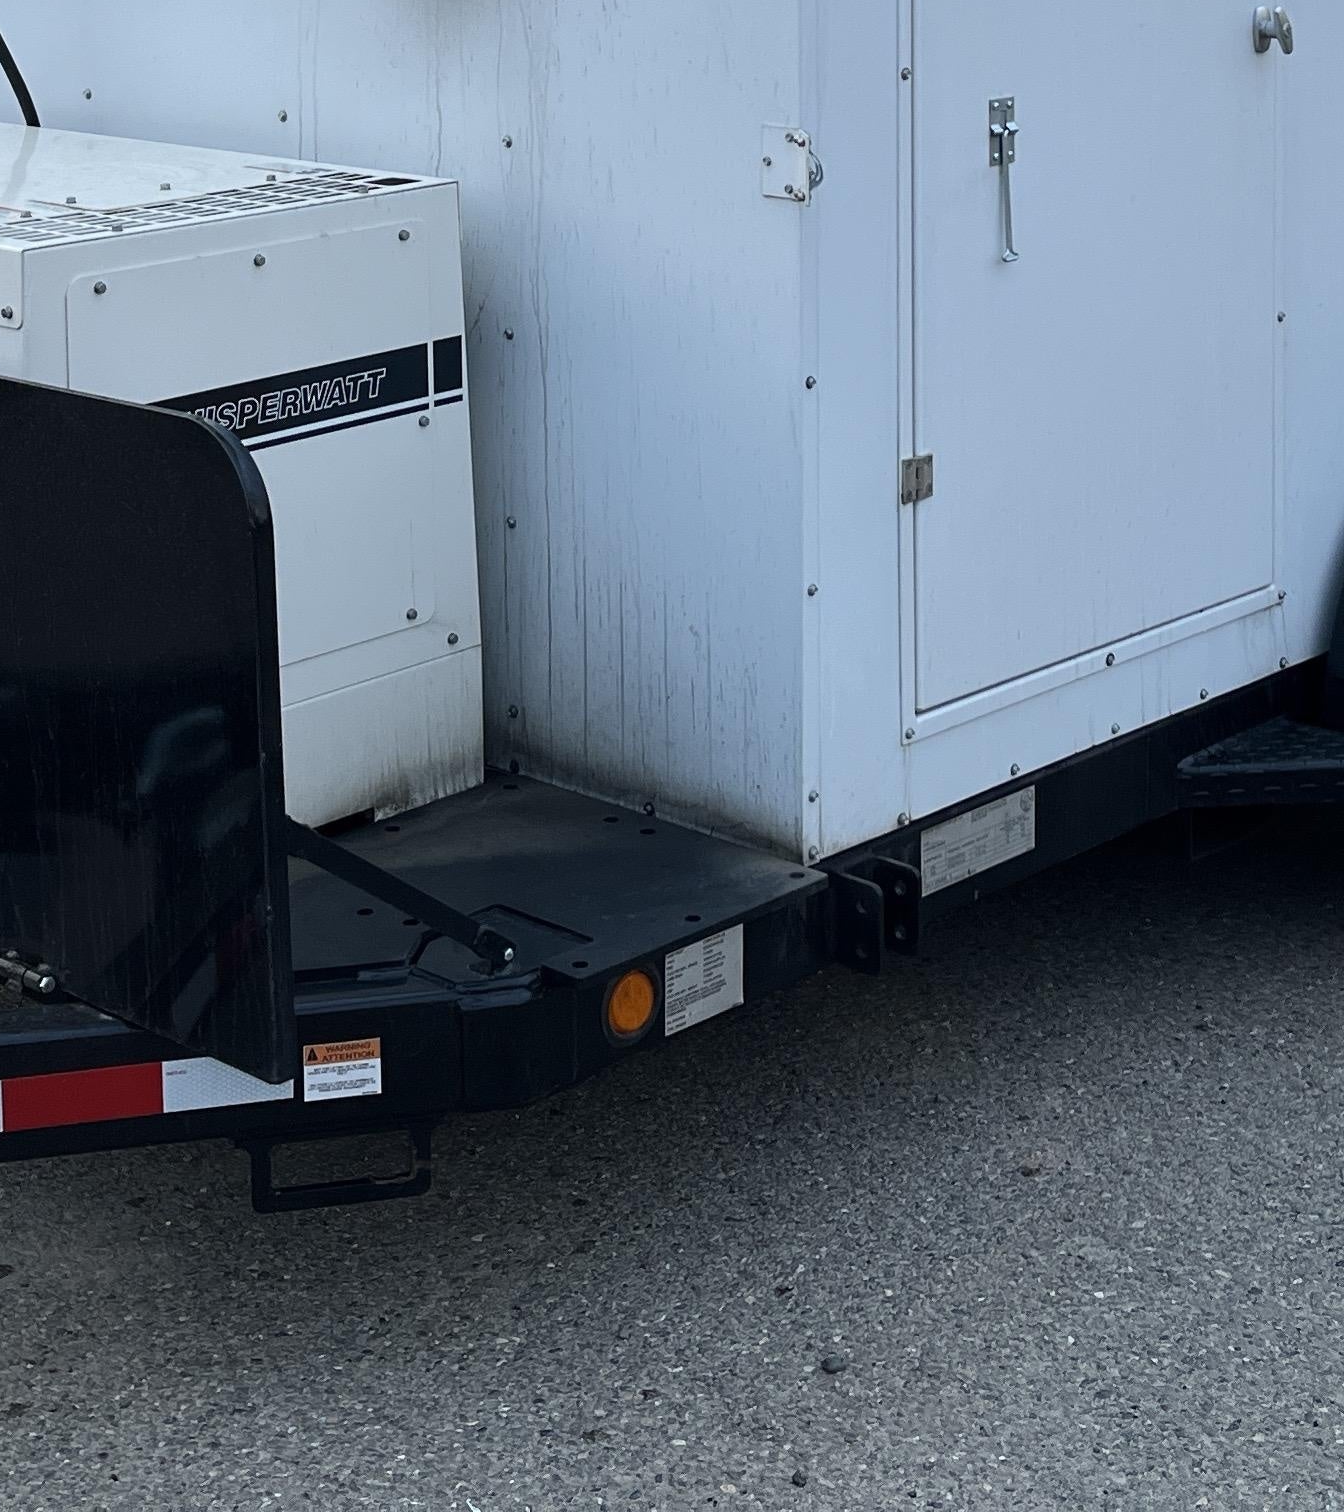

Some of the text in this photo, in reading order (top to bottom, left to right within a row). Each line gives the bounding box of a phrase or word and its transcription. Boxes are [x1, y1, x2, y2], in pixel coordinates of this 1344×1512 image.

[184, 367, 387, 432] ISPERWATT
[325, 1041, 371, 1054] WARNING
[321, 1049, 376, 1062] ATTENTION
